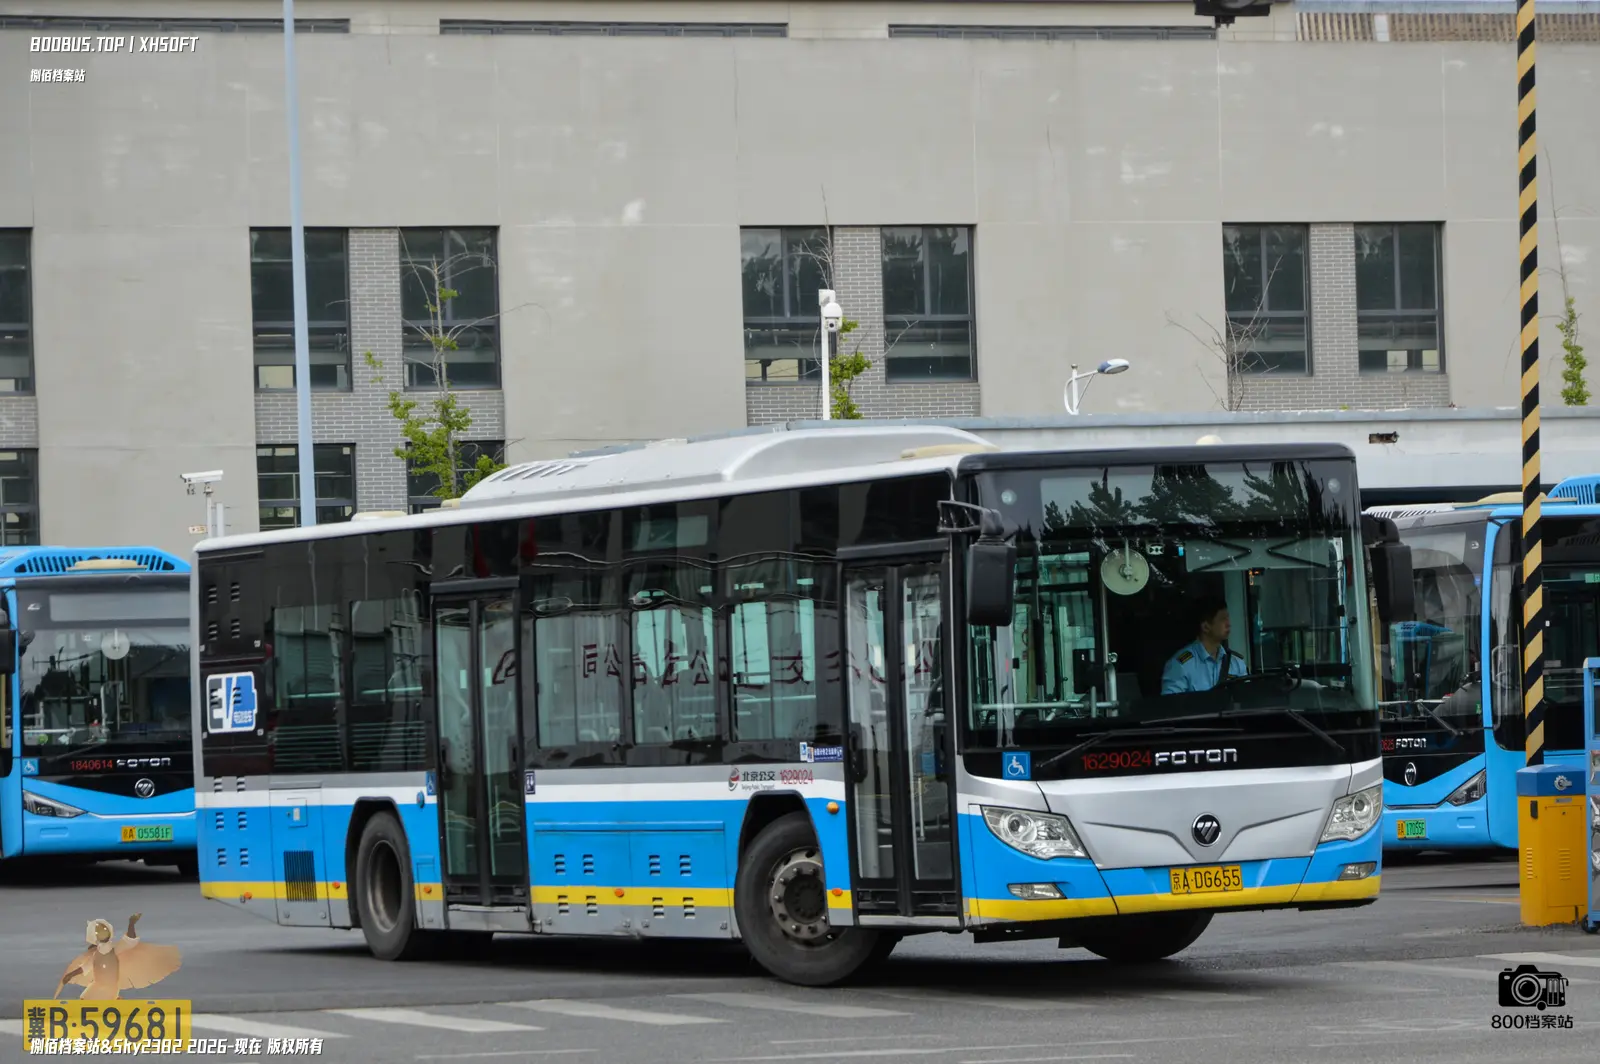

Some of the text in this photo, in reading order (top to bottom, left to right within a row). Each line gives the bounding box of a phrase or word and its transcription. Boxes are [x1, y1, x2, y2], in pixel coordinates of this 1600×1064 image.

[1396, 737, 1427, 748] FOTON
[70, 757, 171, 770] 1840614 FOTON
[1081, 748, 1238, 771] 1629024 FOTON
[742, 769, 814, 785] 北京公交 1629024
